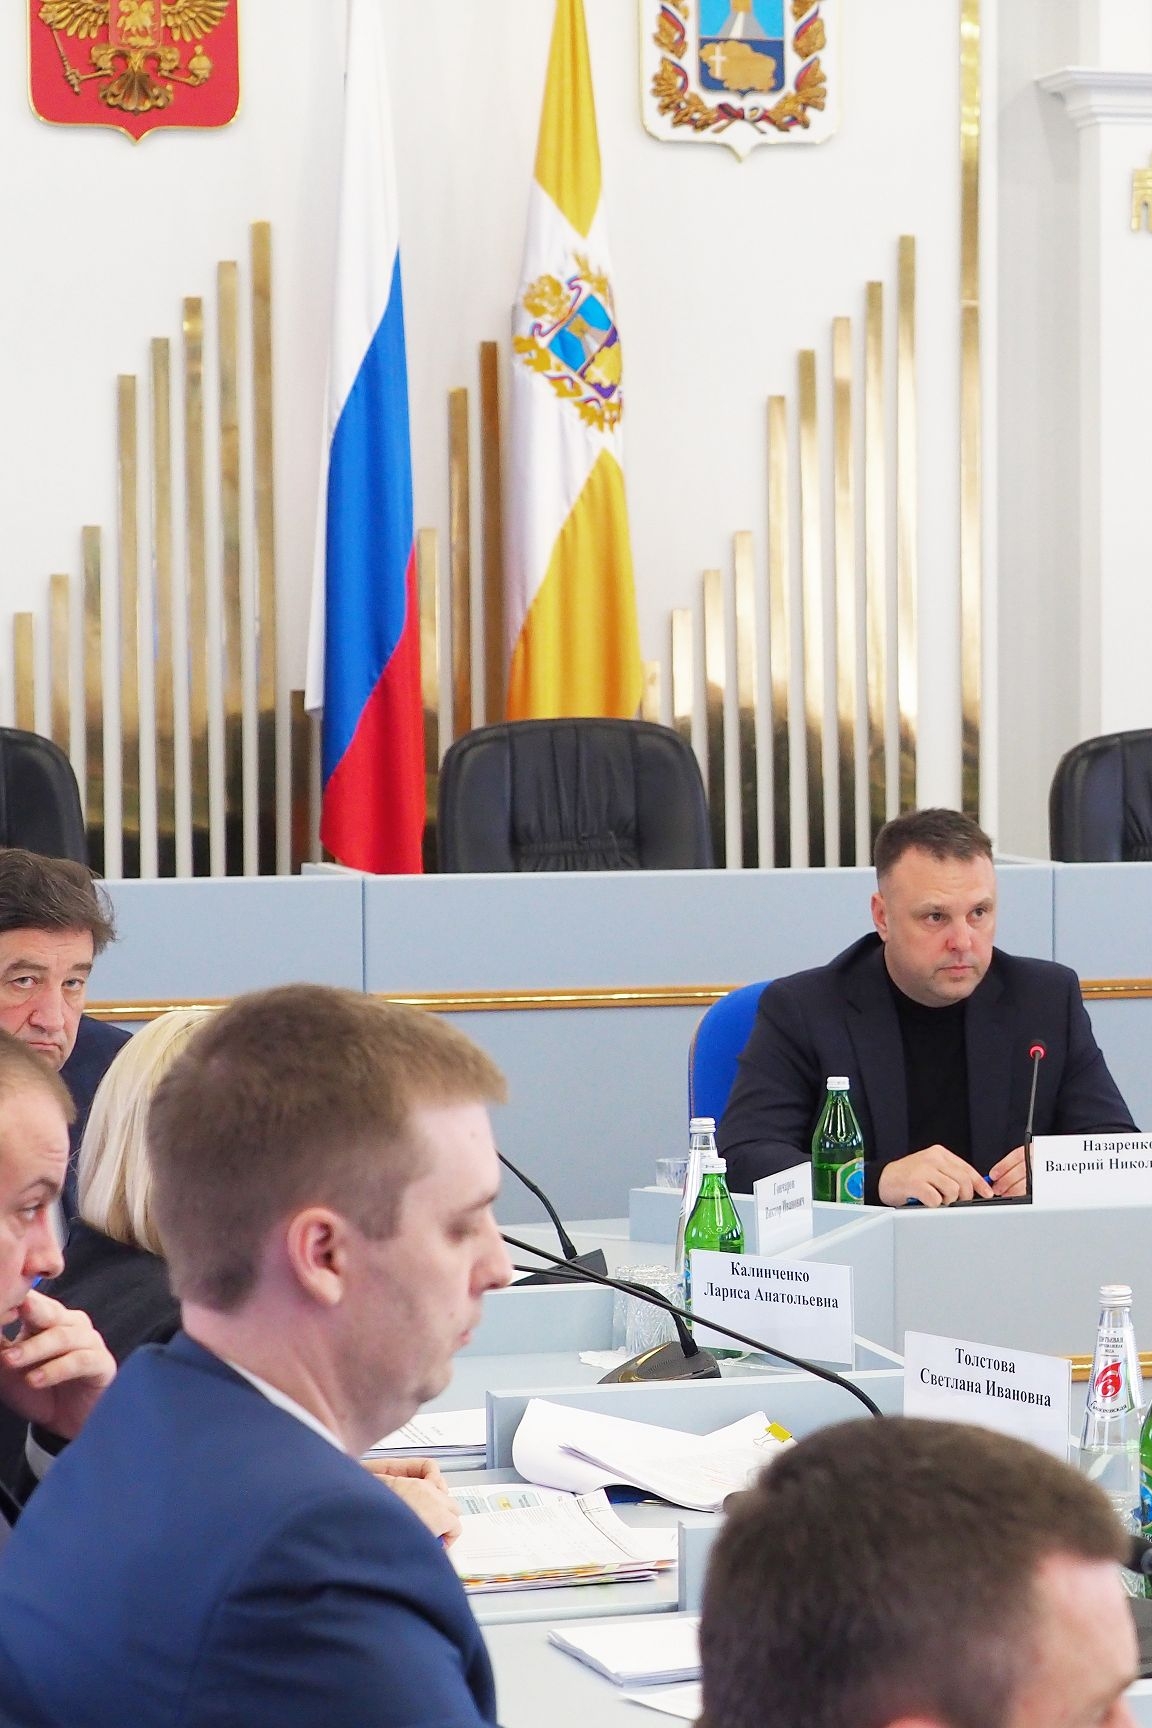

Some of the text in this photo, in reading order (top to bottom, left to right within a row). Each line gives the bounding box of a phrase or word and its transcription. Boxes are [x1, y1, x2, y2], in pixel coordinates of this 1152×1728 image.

[1045, 1159, 1104, 1174] Валерий
[731, 1261, 810, 1282] Калинченко
[703, 1281, 839, 1308] Лариса Анатольевна
[955, 1347, 1016, 1373] Толстова
[920, 1367, 1052, 1407] Светлана Ивановна
